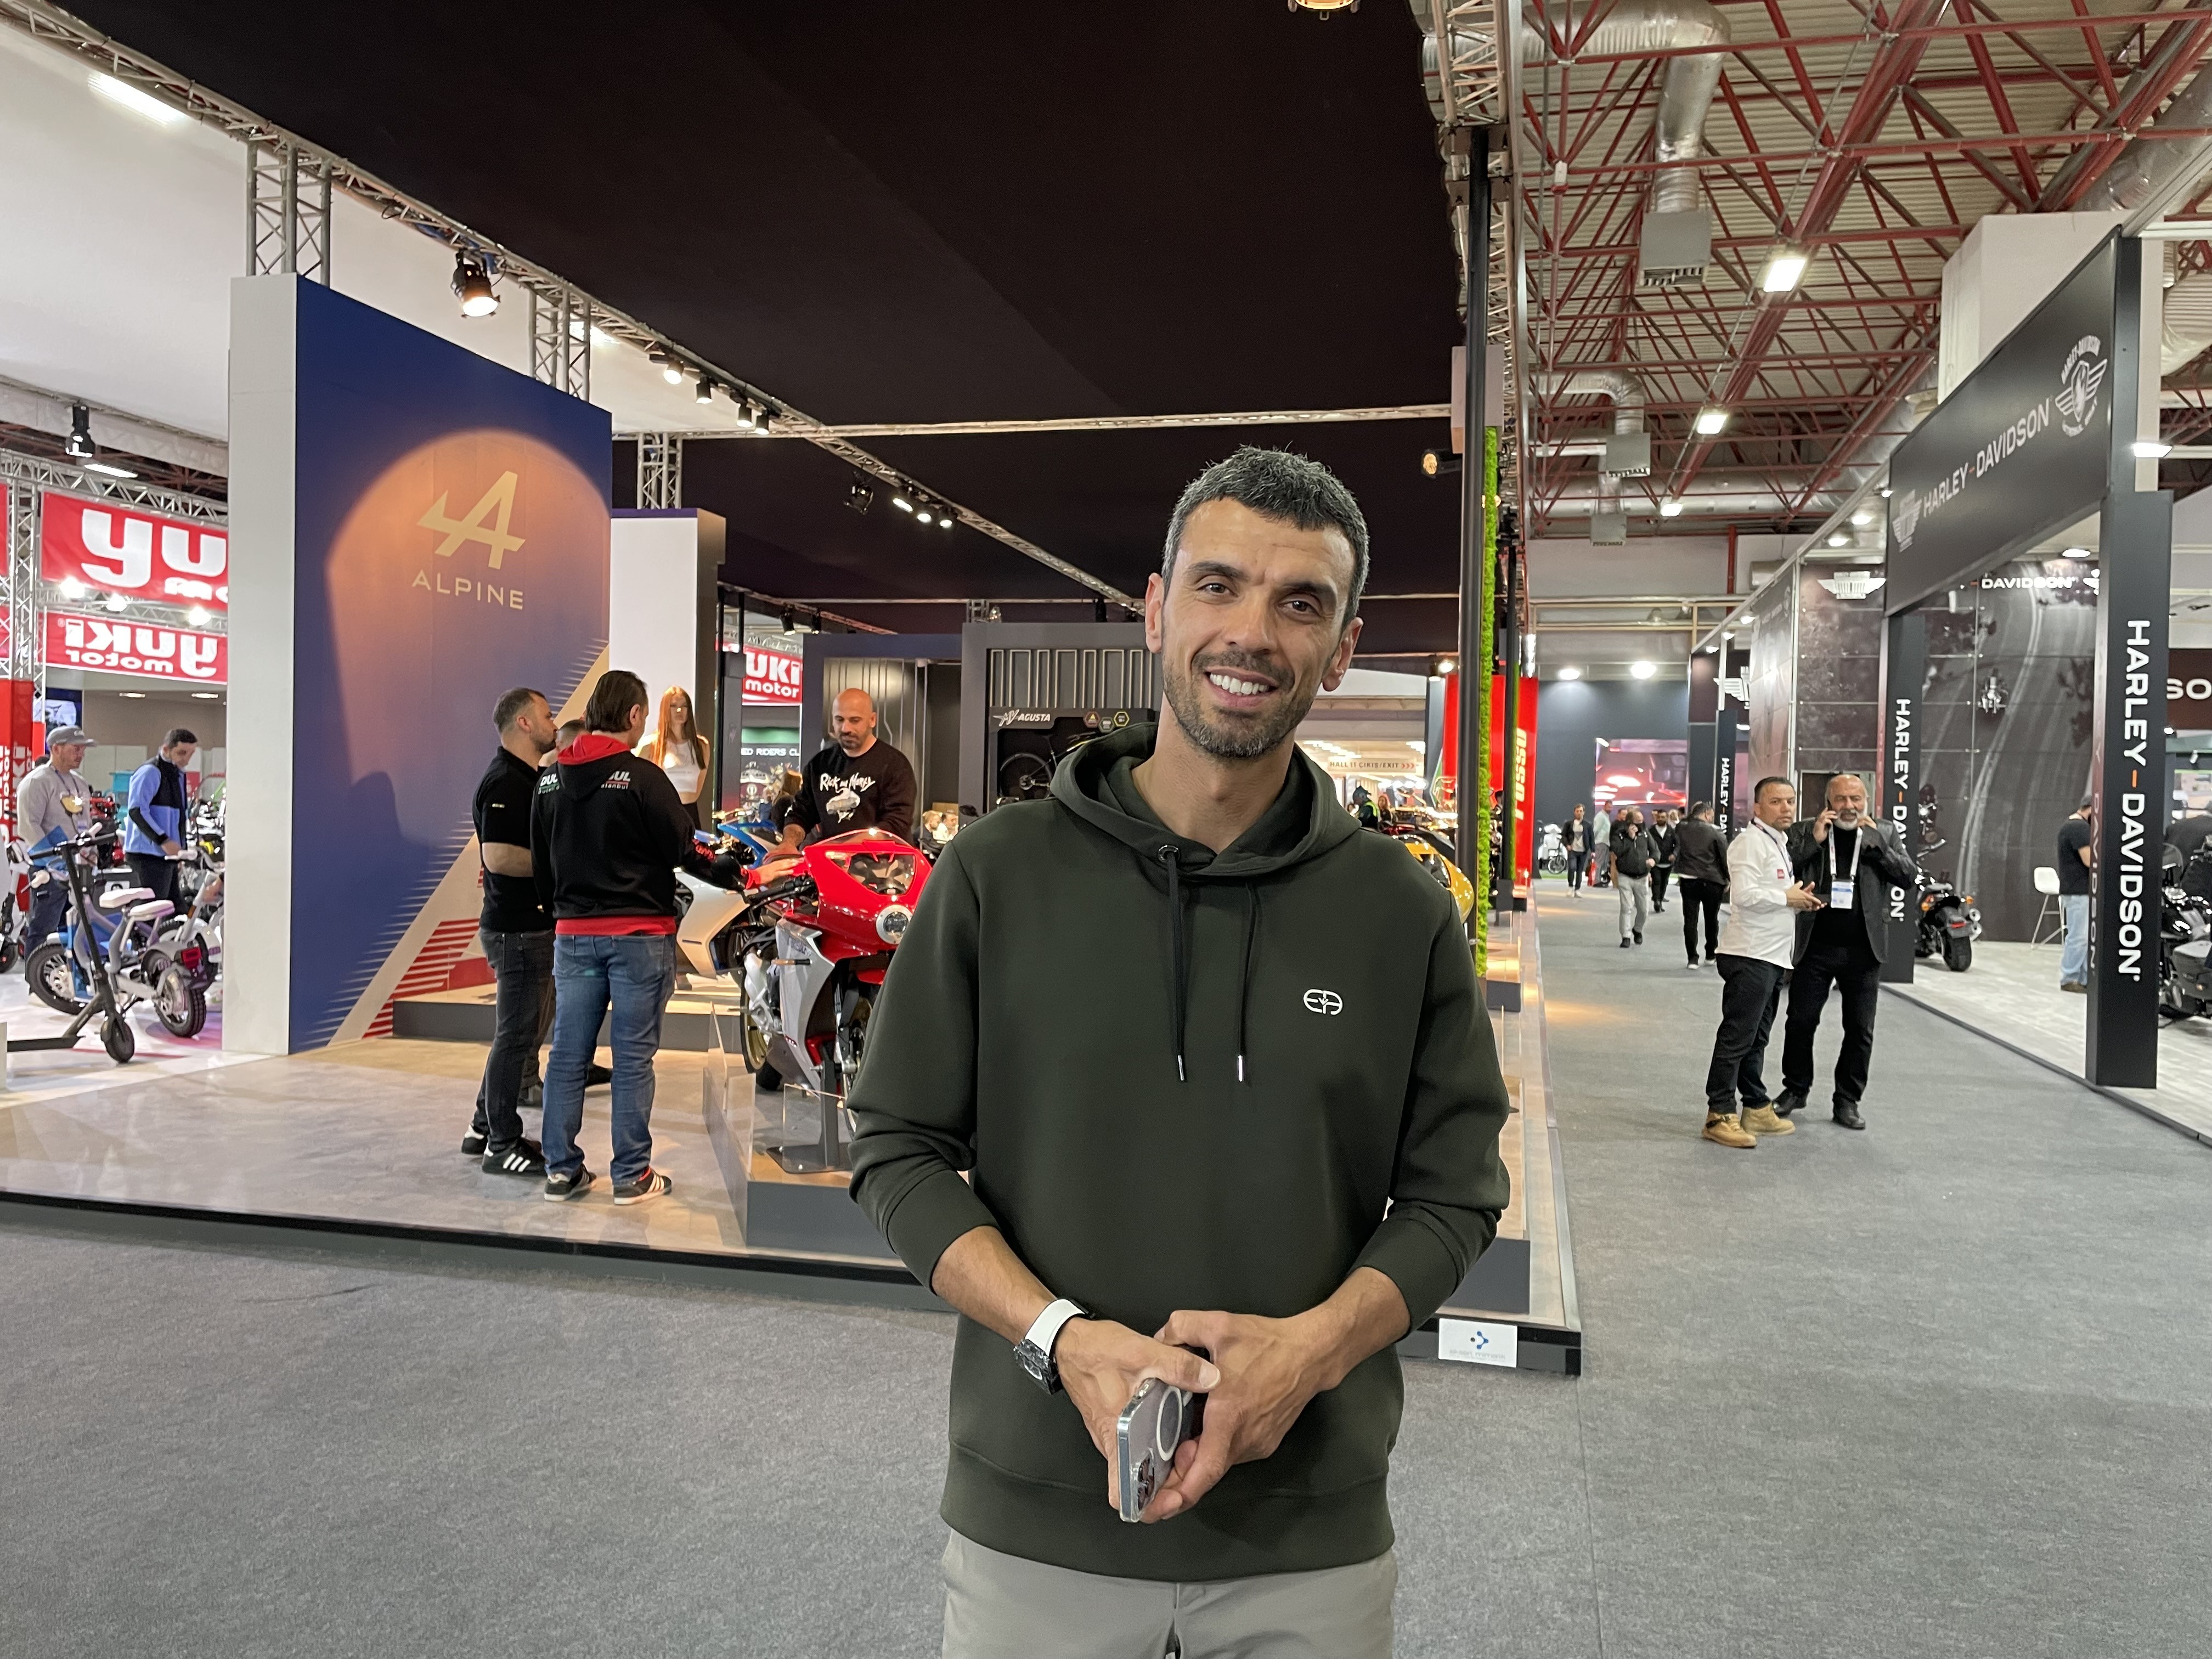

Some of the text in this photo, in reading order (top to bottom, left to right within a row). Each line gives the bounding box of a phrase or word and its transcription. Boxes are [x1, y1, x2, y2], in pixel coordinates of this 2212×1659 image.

[1923, 398, 2050, 517] HARLEY-DAVIDSON
[412, 569, 523, 610] ALPINE
[745, 679, 799, 698] motor
[1017, 714, 1051, 722] AGUSTA
[756, 748, 786, 756] RIDERS
[1890, 698, 1911, 918] HARLEY-DAON
[2118, 620, 2151, 975] HARLEY-DAVIDSON
